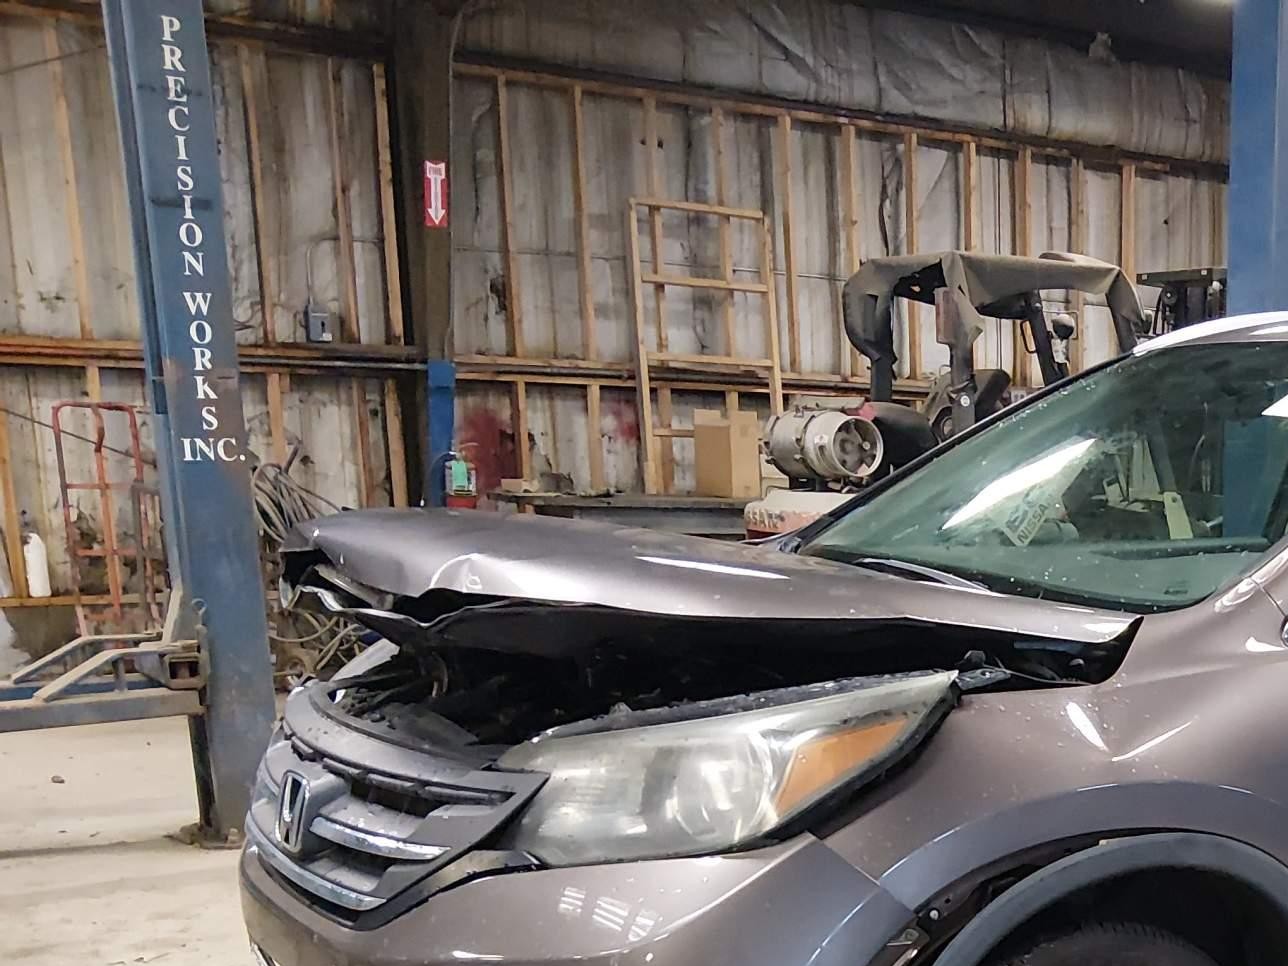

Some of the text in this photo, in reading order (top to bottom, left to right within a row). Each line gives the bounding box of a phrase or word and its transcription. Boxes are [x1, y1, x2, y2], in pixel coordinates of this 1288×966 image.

[160, 15, 246, 462] PRECISION WORKS INC.
